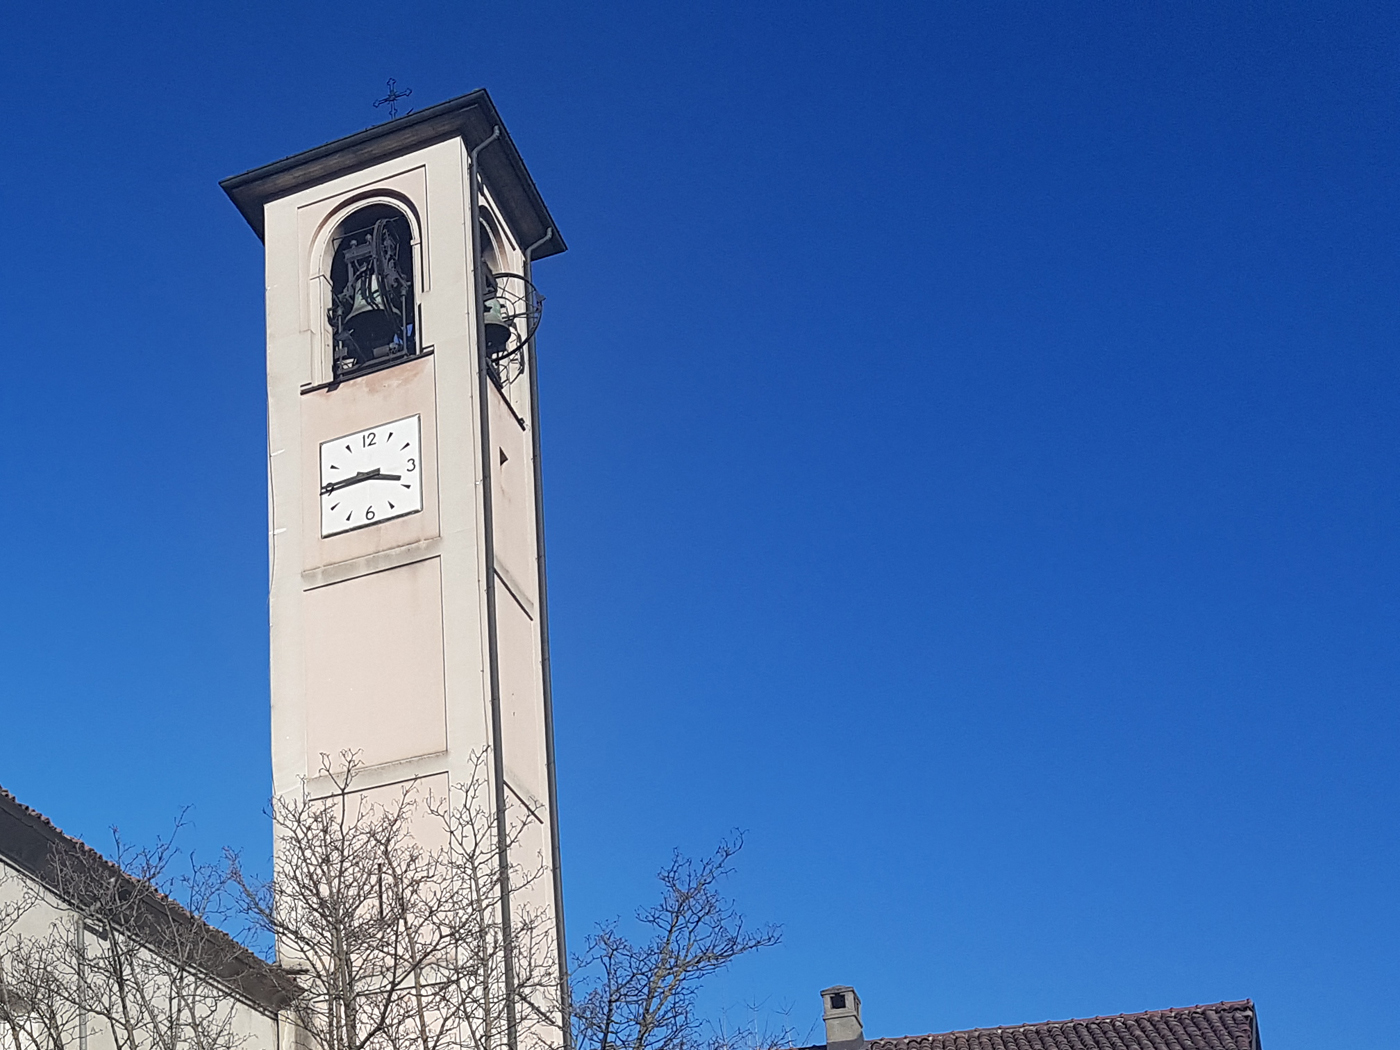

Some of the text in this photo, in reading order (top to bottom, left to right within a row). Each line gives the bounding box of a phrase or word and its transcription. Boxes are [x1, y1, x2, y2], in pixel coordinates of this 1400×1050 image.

[362, 432, 377, 448] 12
[406, 458, 417, 472] 3
[365, 505, 376, 520] 6
